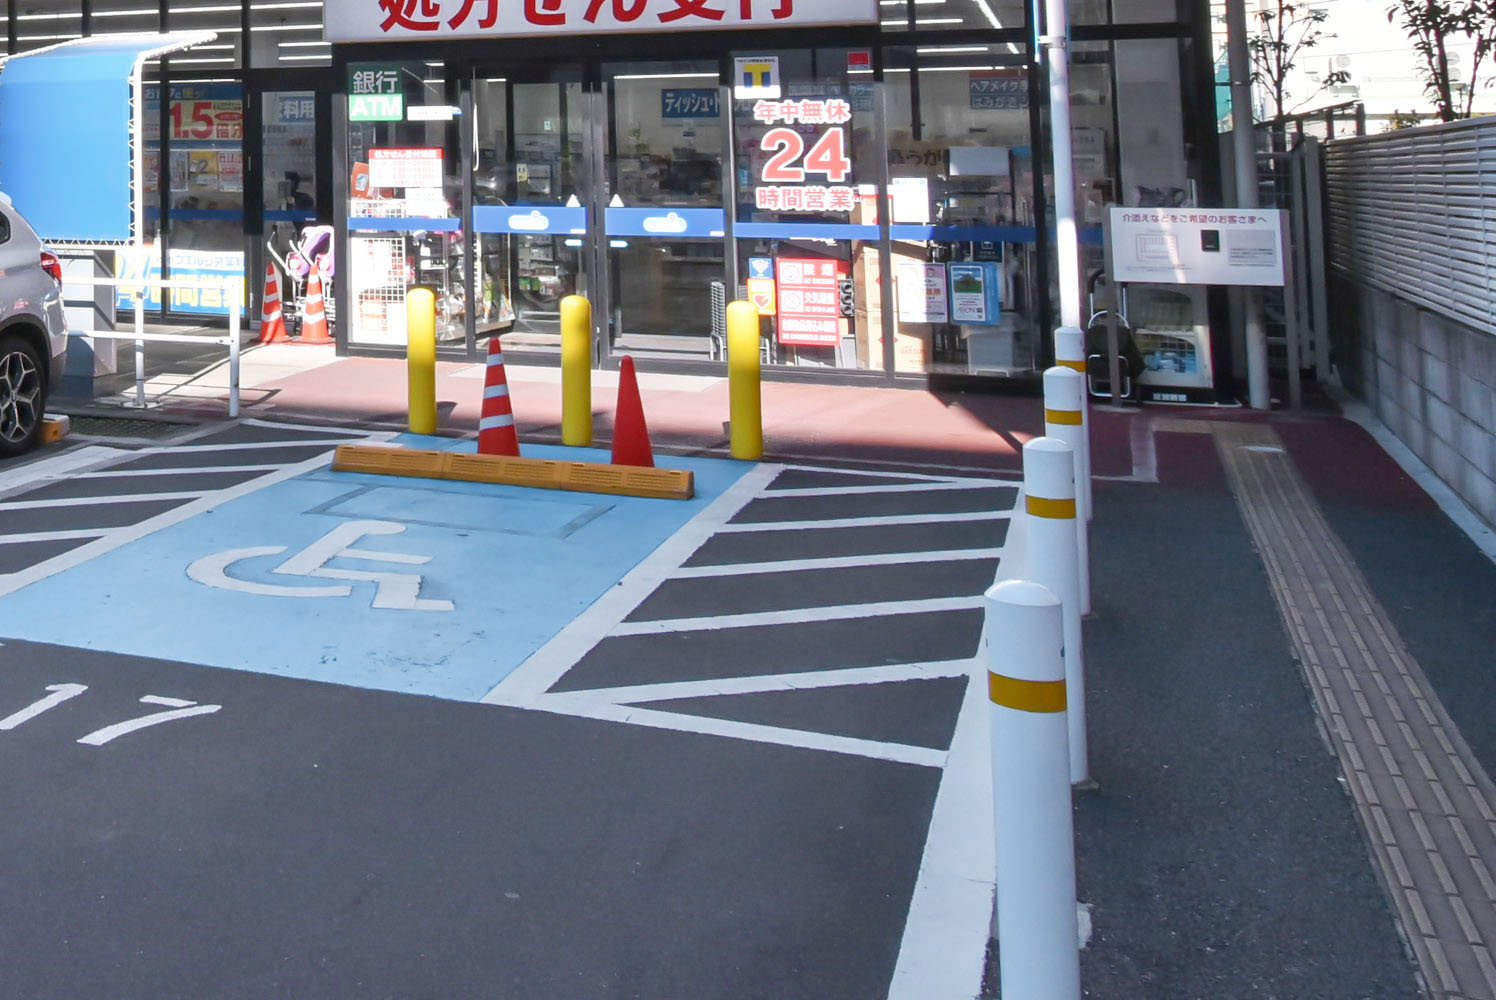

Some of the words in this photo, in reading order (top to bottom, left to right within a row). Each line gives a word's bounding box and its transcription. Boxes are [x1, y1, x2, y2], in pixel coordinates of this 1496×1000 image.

[352, 70, 398, 94] 銀行
[351, 96, 401, 117] ATM
[754, 100, 851, 124] 年中無休
[760, 126, 851, 182] 24
[756, 185, 854, 211] 時間営業
